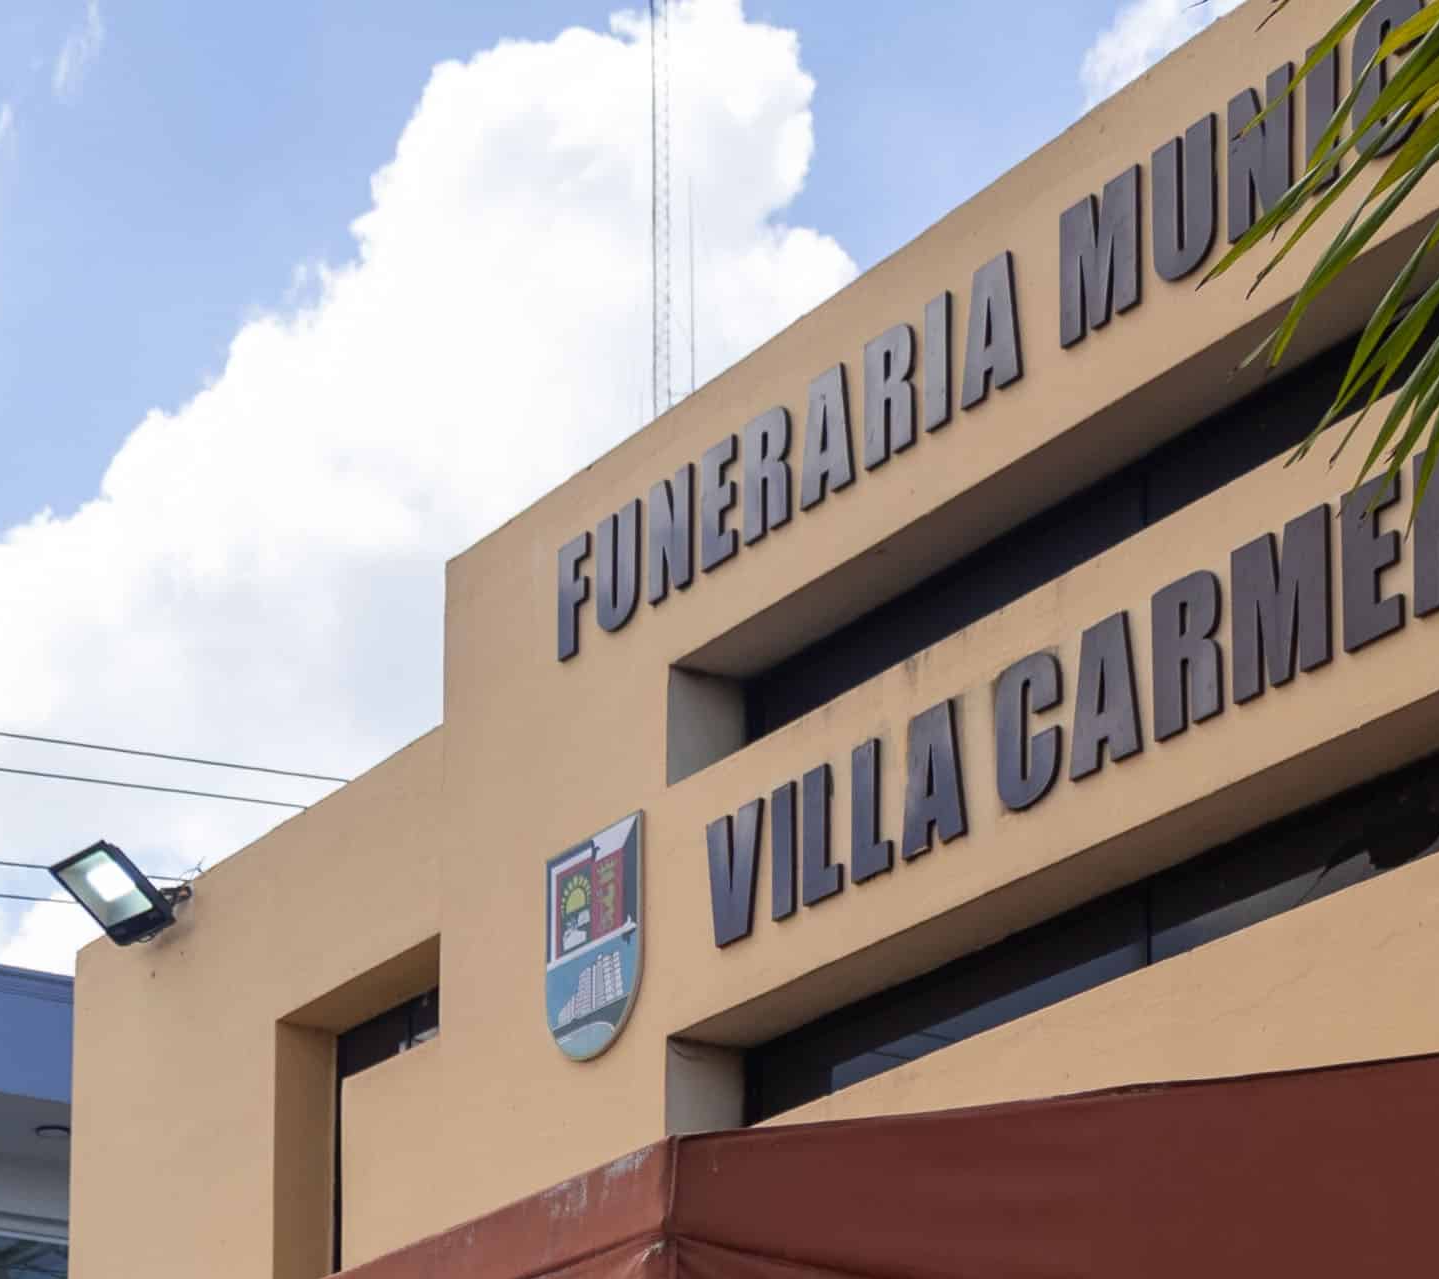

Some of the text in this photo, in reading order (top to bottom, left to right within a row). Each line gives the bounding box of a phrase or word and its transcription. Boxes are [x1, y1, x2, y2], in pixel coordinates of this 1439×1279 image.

[556, 0, 1426, 663] FUNERARIA MUNIC
[704, 702, 968, 949] VILLA
